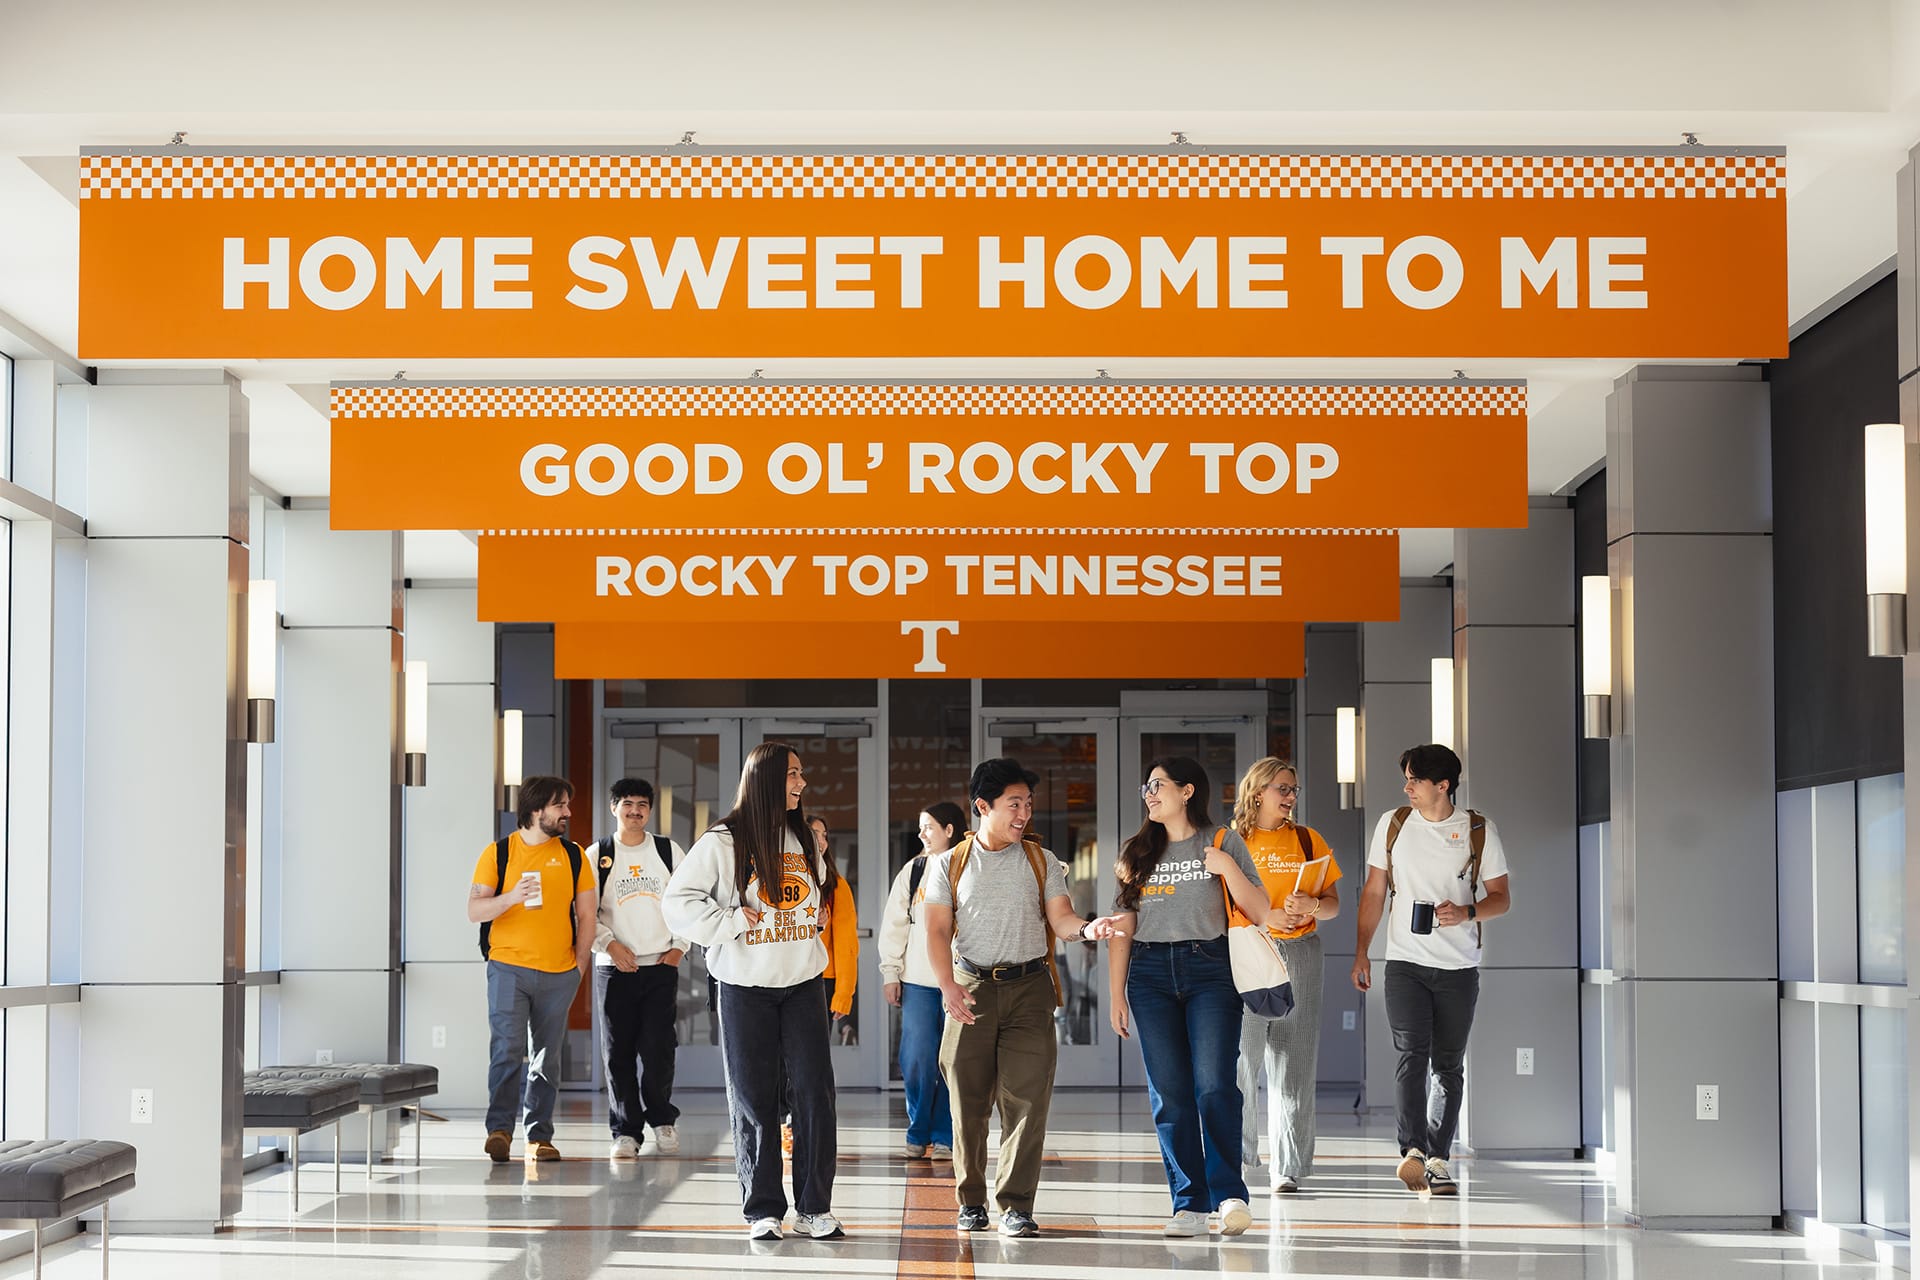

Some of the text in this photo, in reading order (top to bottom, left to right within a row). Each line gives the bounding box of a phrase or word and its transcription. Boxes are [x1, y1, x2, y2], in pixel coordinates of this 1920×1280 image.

[223, 236, 1648, 310] HOME SWEET HOME TO ME
[520, 443, 743, 496] GOOD
[909, 442, 1168, 494] ROCKY
[1190, 442, 1339, 494] TOP
[596, 555, 1282, 597] ROCKY TOP TENNESSEE
[901, 621, 959, 673] T
[1154, 859, 1202, 873] ange
[1267, 852, 1282, 862] the
[1147, 869, 1213, 885] appens
[779, 885, 801, 903] 98
[774, 910, 797, 927] SEC
